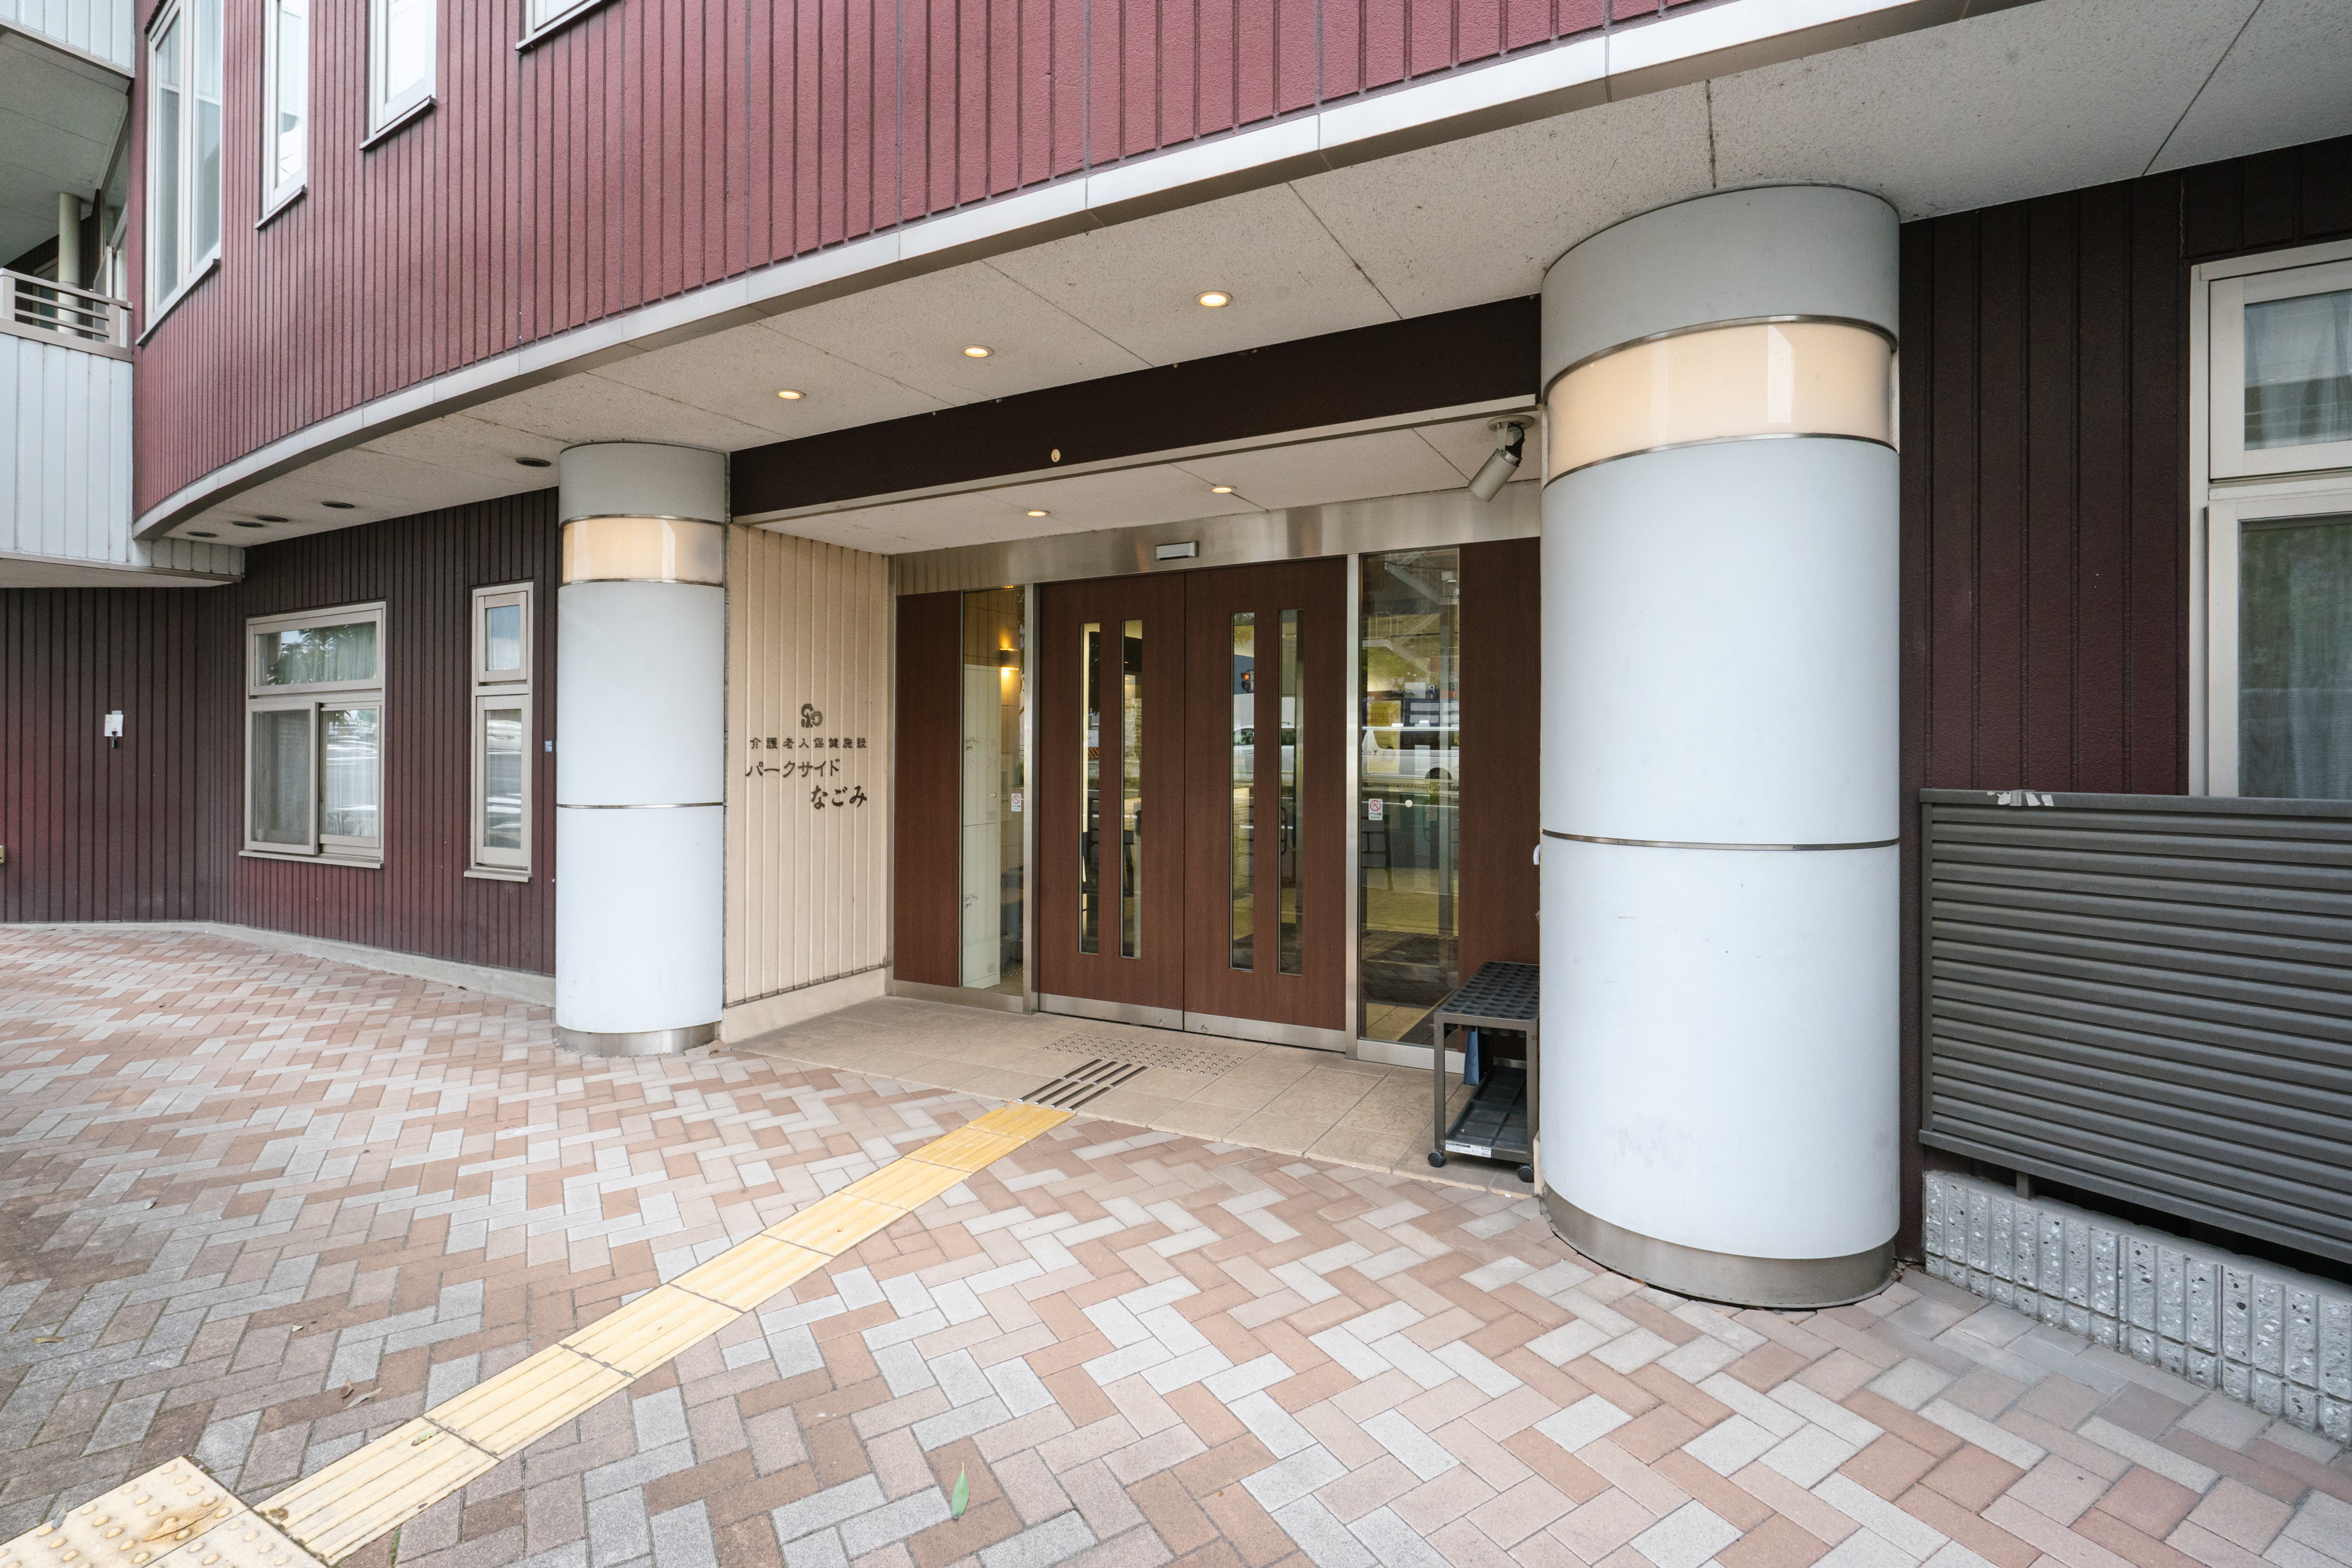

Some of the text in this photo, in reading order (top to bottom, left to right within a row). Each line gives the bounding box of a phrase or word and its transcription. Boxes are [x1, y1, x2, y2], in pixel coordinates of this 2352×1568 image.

[750, 737, 867, 749] 介護老人保健施設
[745, 758, 840, 777] パークサイド
[811, 785, 867, 810] なごみ
